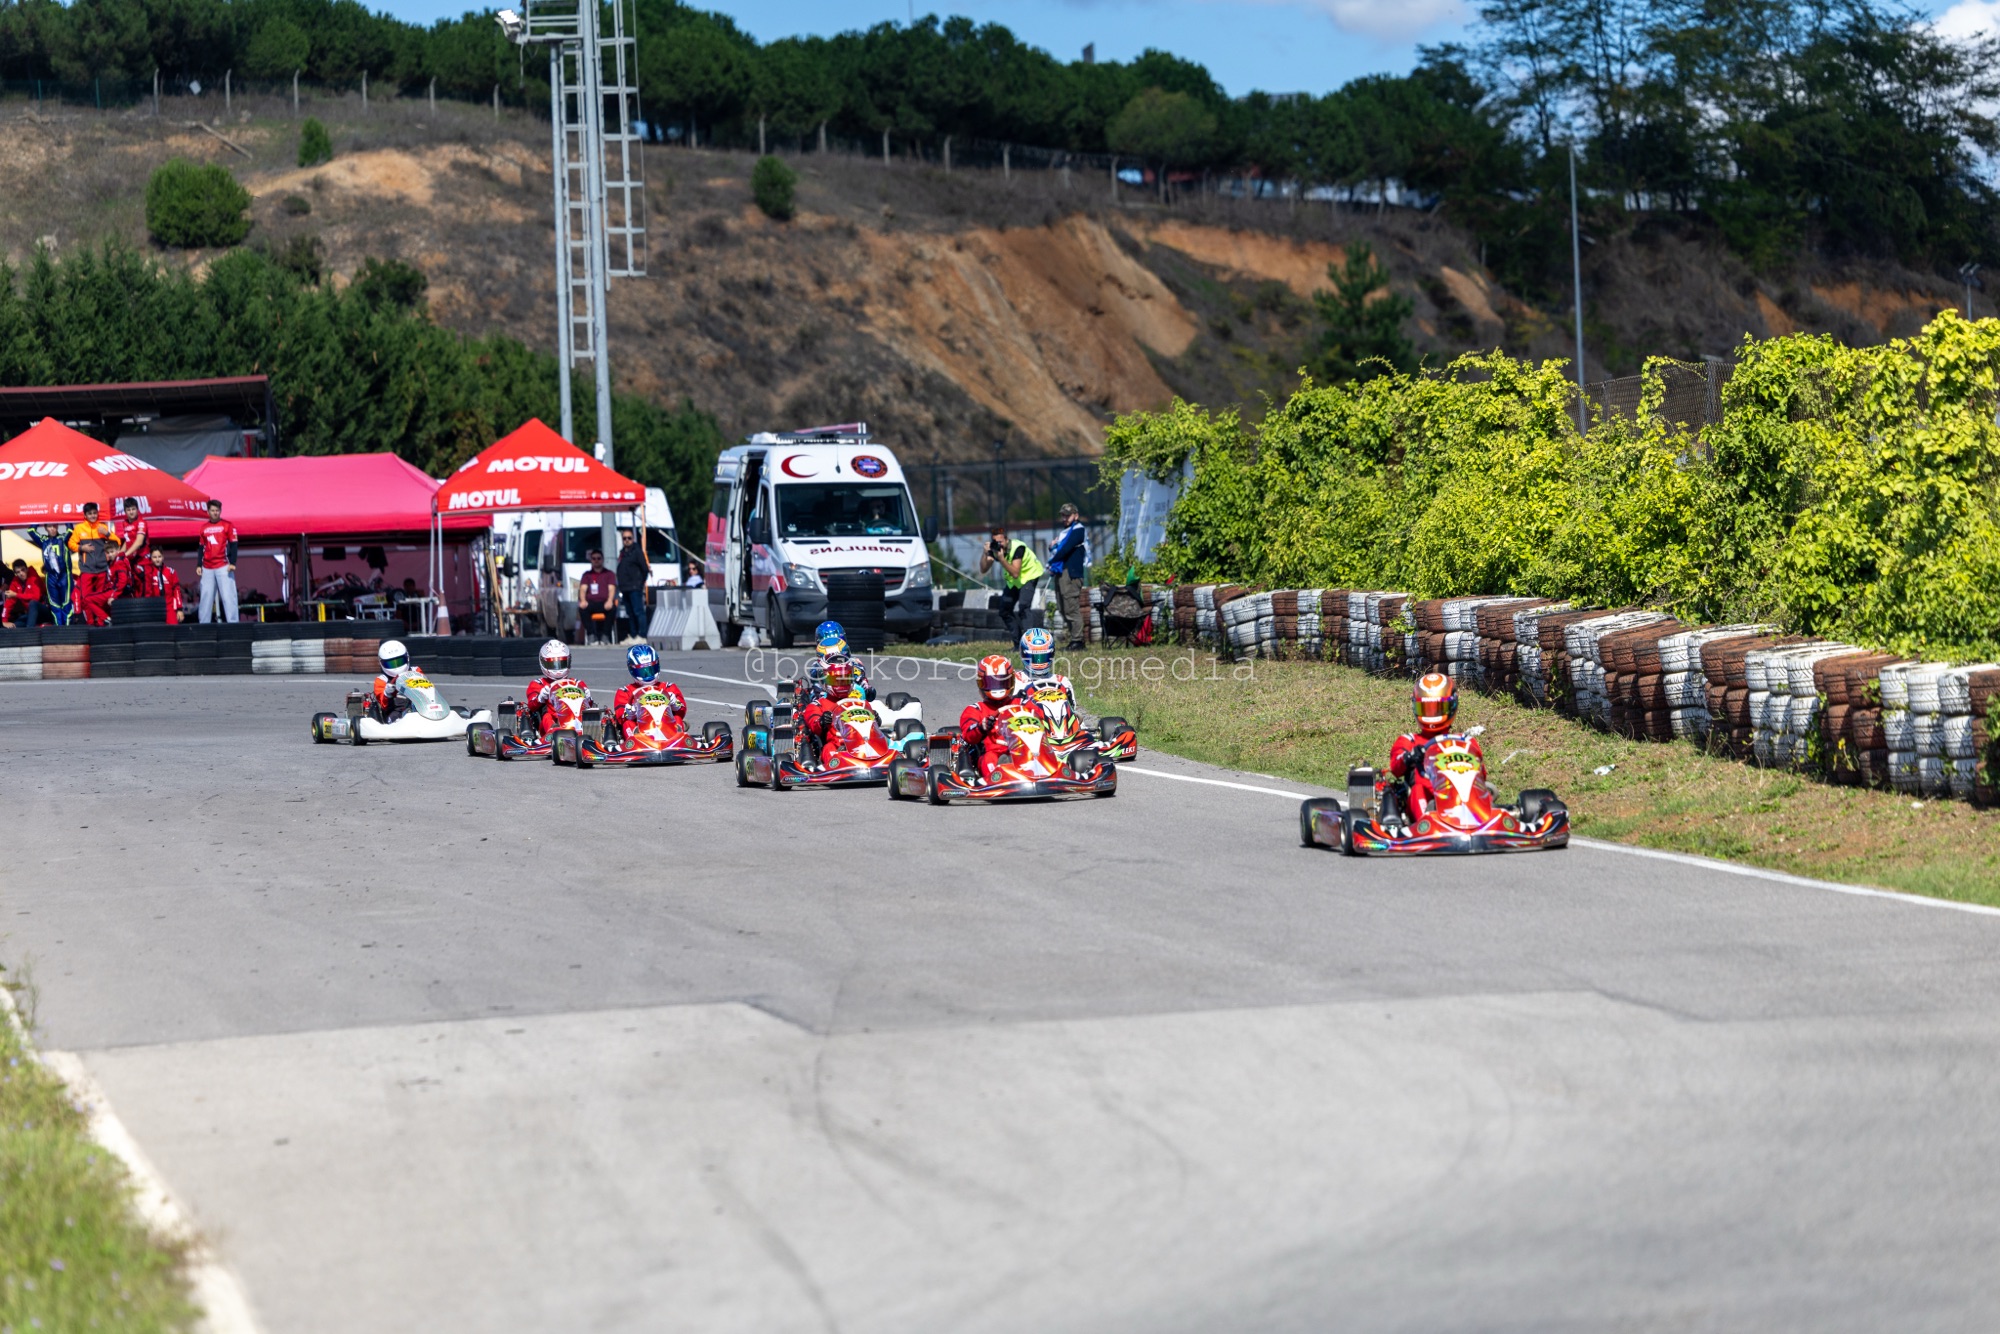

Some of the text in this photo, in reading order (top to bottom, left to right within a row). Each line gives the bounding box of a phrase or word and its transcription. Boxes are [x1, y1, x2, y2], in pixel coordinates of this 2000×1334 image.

[487, 456, 590, 473] MOTUL
[115, 495, 152, 516] MUL
[448, 488, 522, 509] MOTUL
